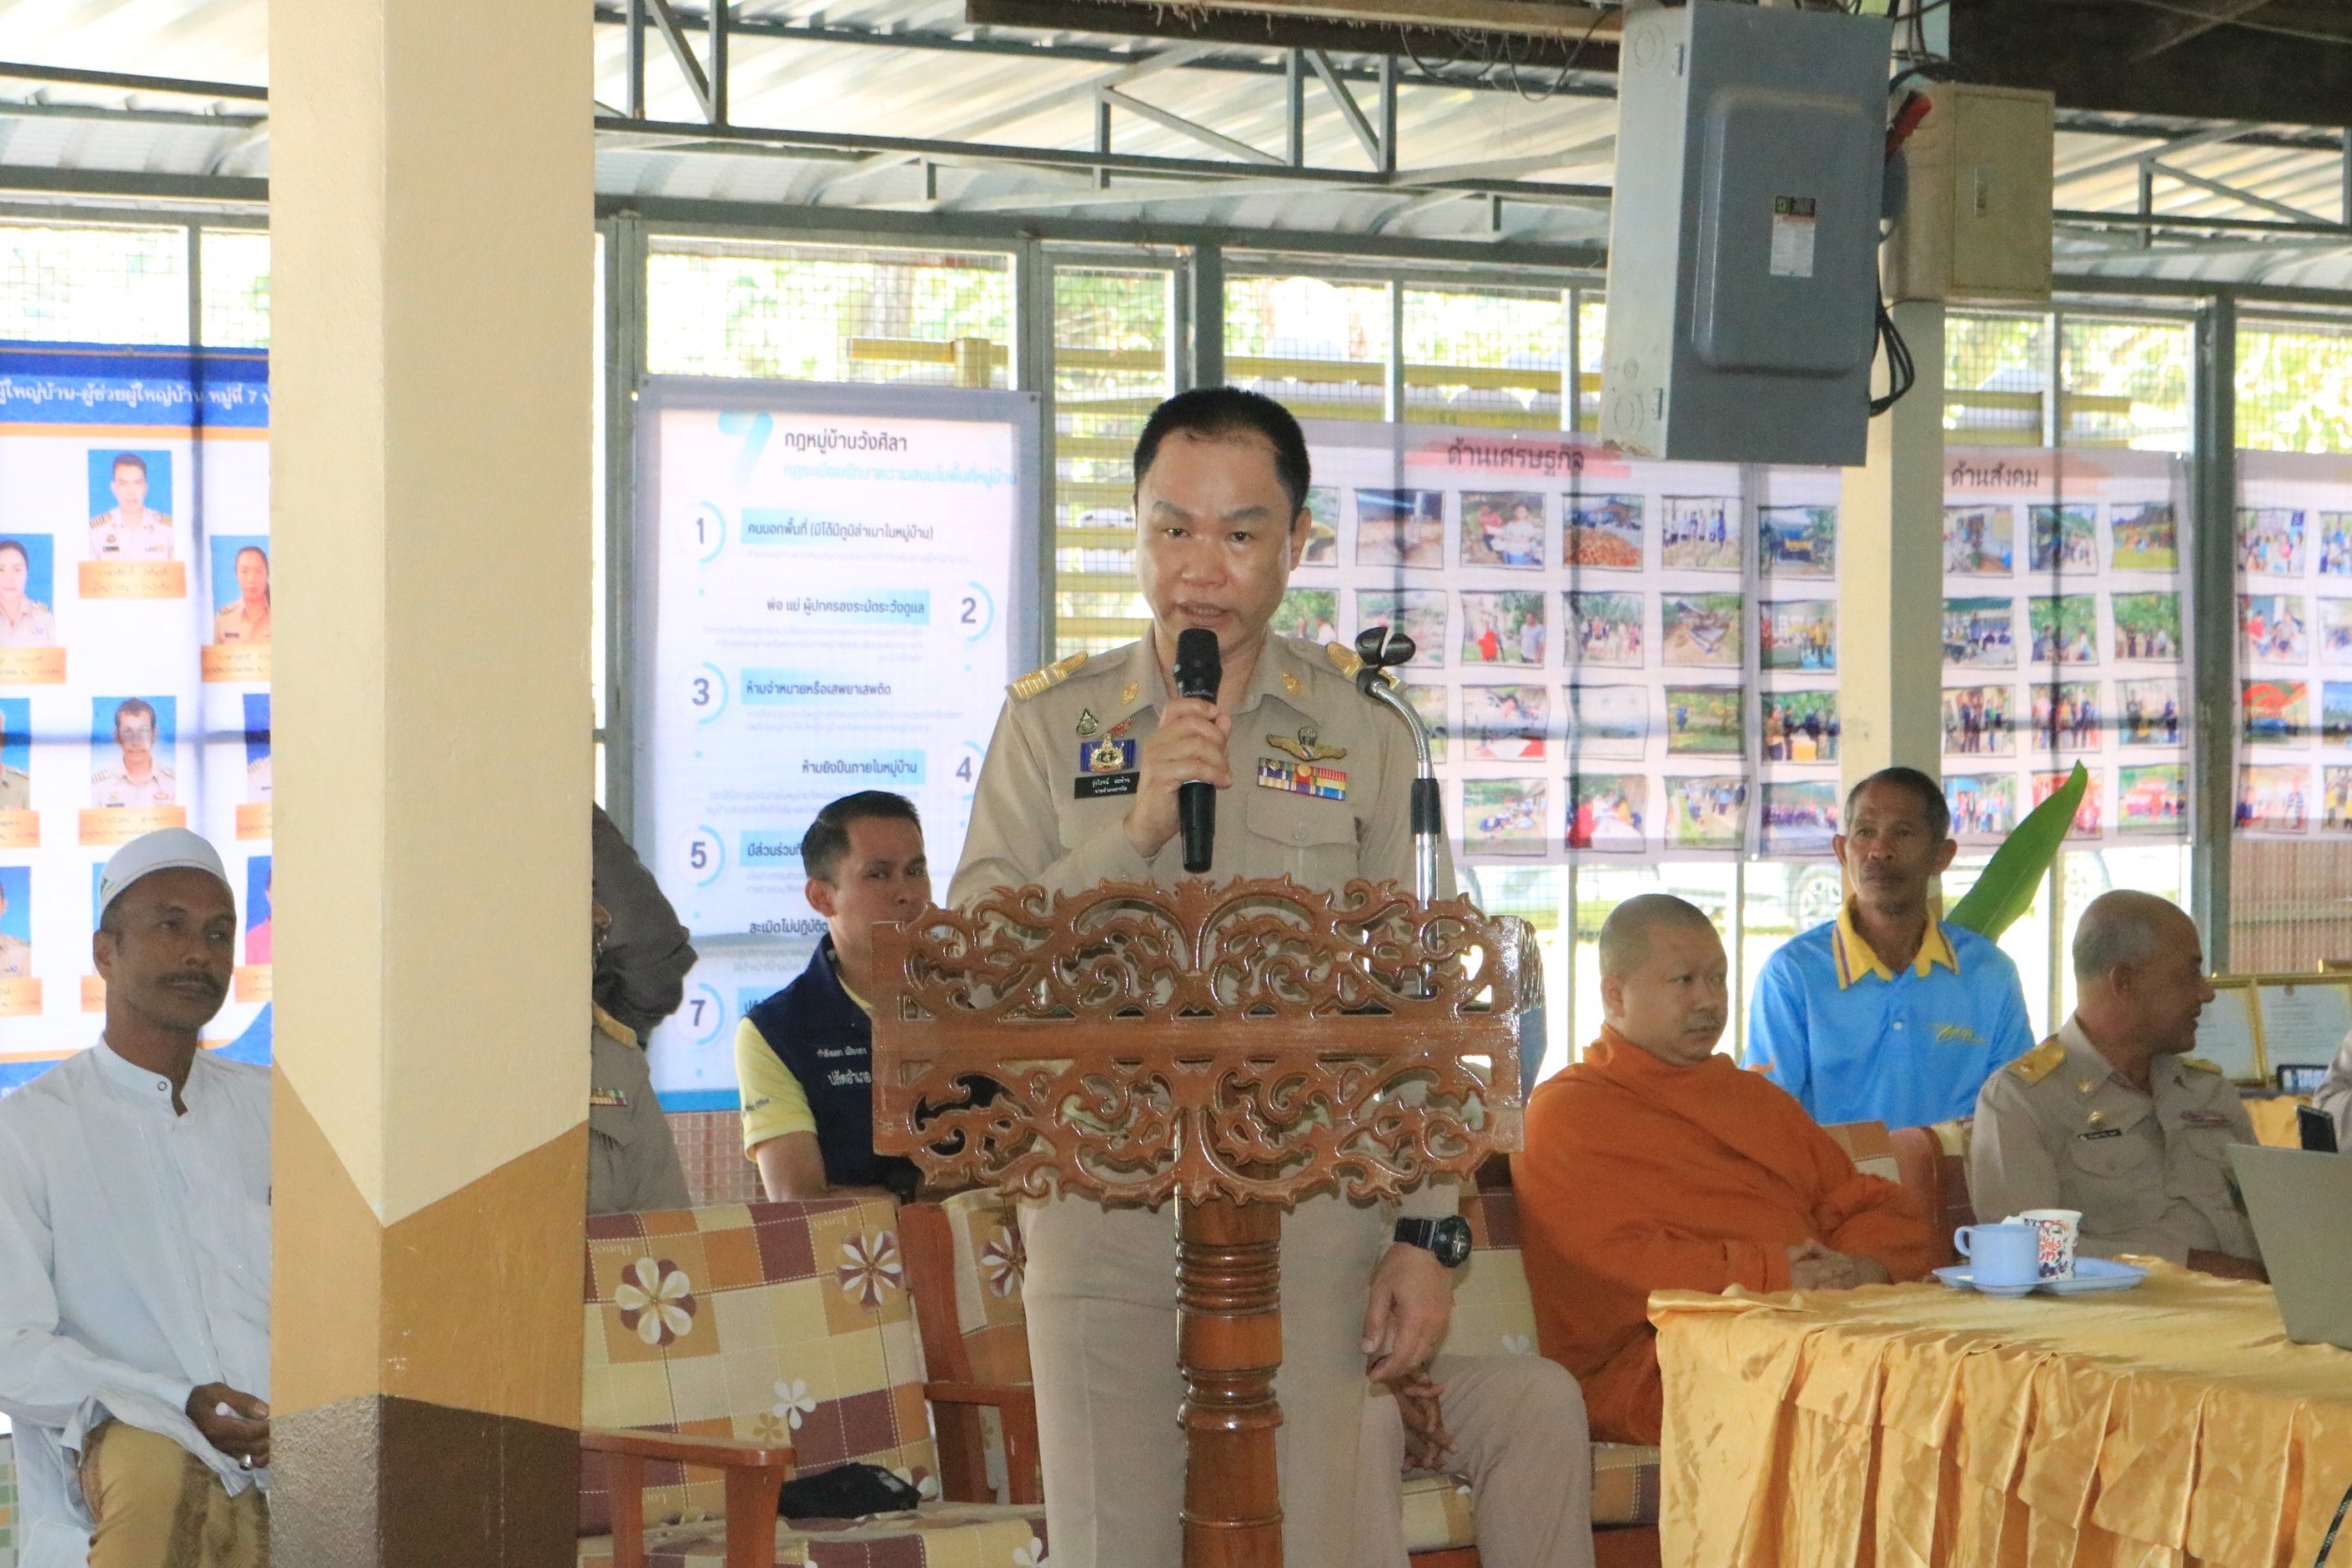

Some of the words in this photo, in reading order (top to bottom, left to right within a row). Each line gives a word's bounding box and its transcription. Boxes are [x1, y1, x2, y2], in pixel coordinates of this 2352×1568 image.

[209, 383, 242, 410] หมู่ที่
[248, 389, 258, 404] 7
[784, 429, 908, 454] กฎหมู่บ้านวังศิลา
[1447, 436, 1585, 476] ด้านเศรษฐกิจ
[1951, 460, 2039, 487] ด้านสังคม
[695, 518, 706, 545] 1
[747, 518, 808, 537] คนนอกพื้นที่
[766, 598, 784, 612] พ่อ
[786, 598, 801, 613] แม่
[803, 597, 926, 618] ผู้ปกครองระมัดระวังดูแล
[959, 596, 977, 625] 2
[691, 678, 710, 706] 3
[802, 758, 918, 778] ห้ามยิงปืนภายในหมู่บ้าน
[955, 756, 972, 783] 4
[689, 841, 707, 869] 5
[689, 999, 707, 1027] 7
